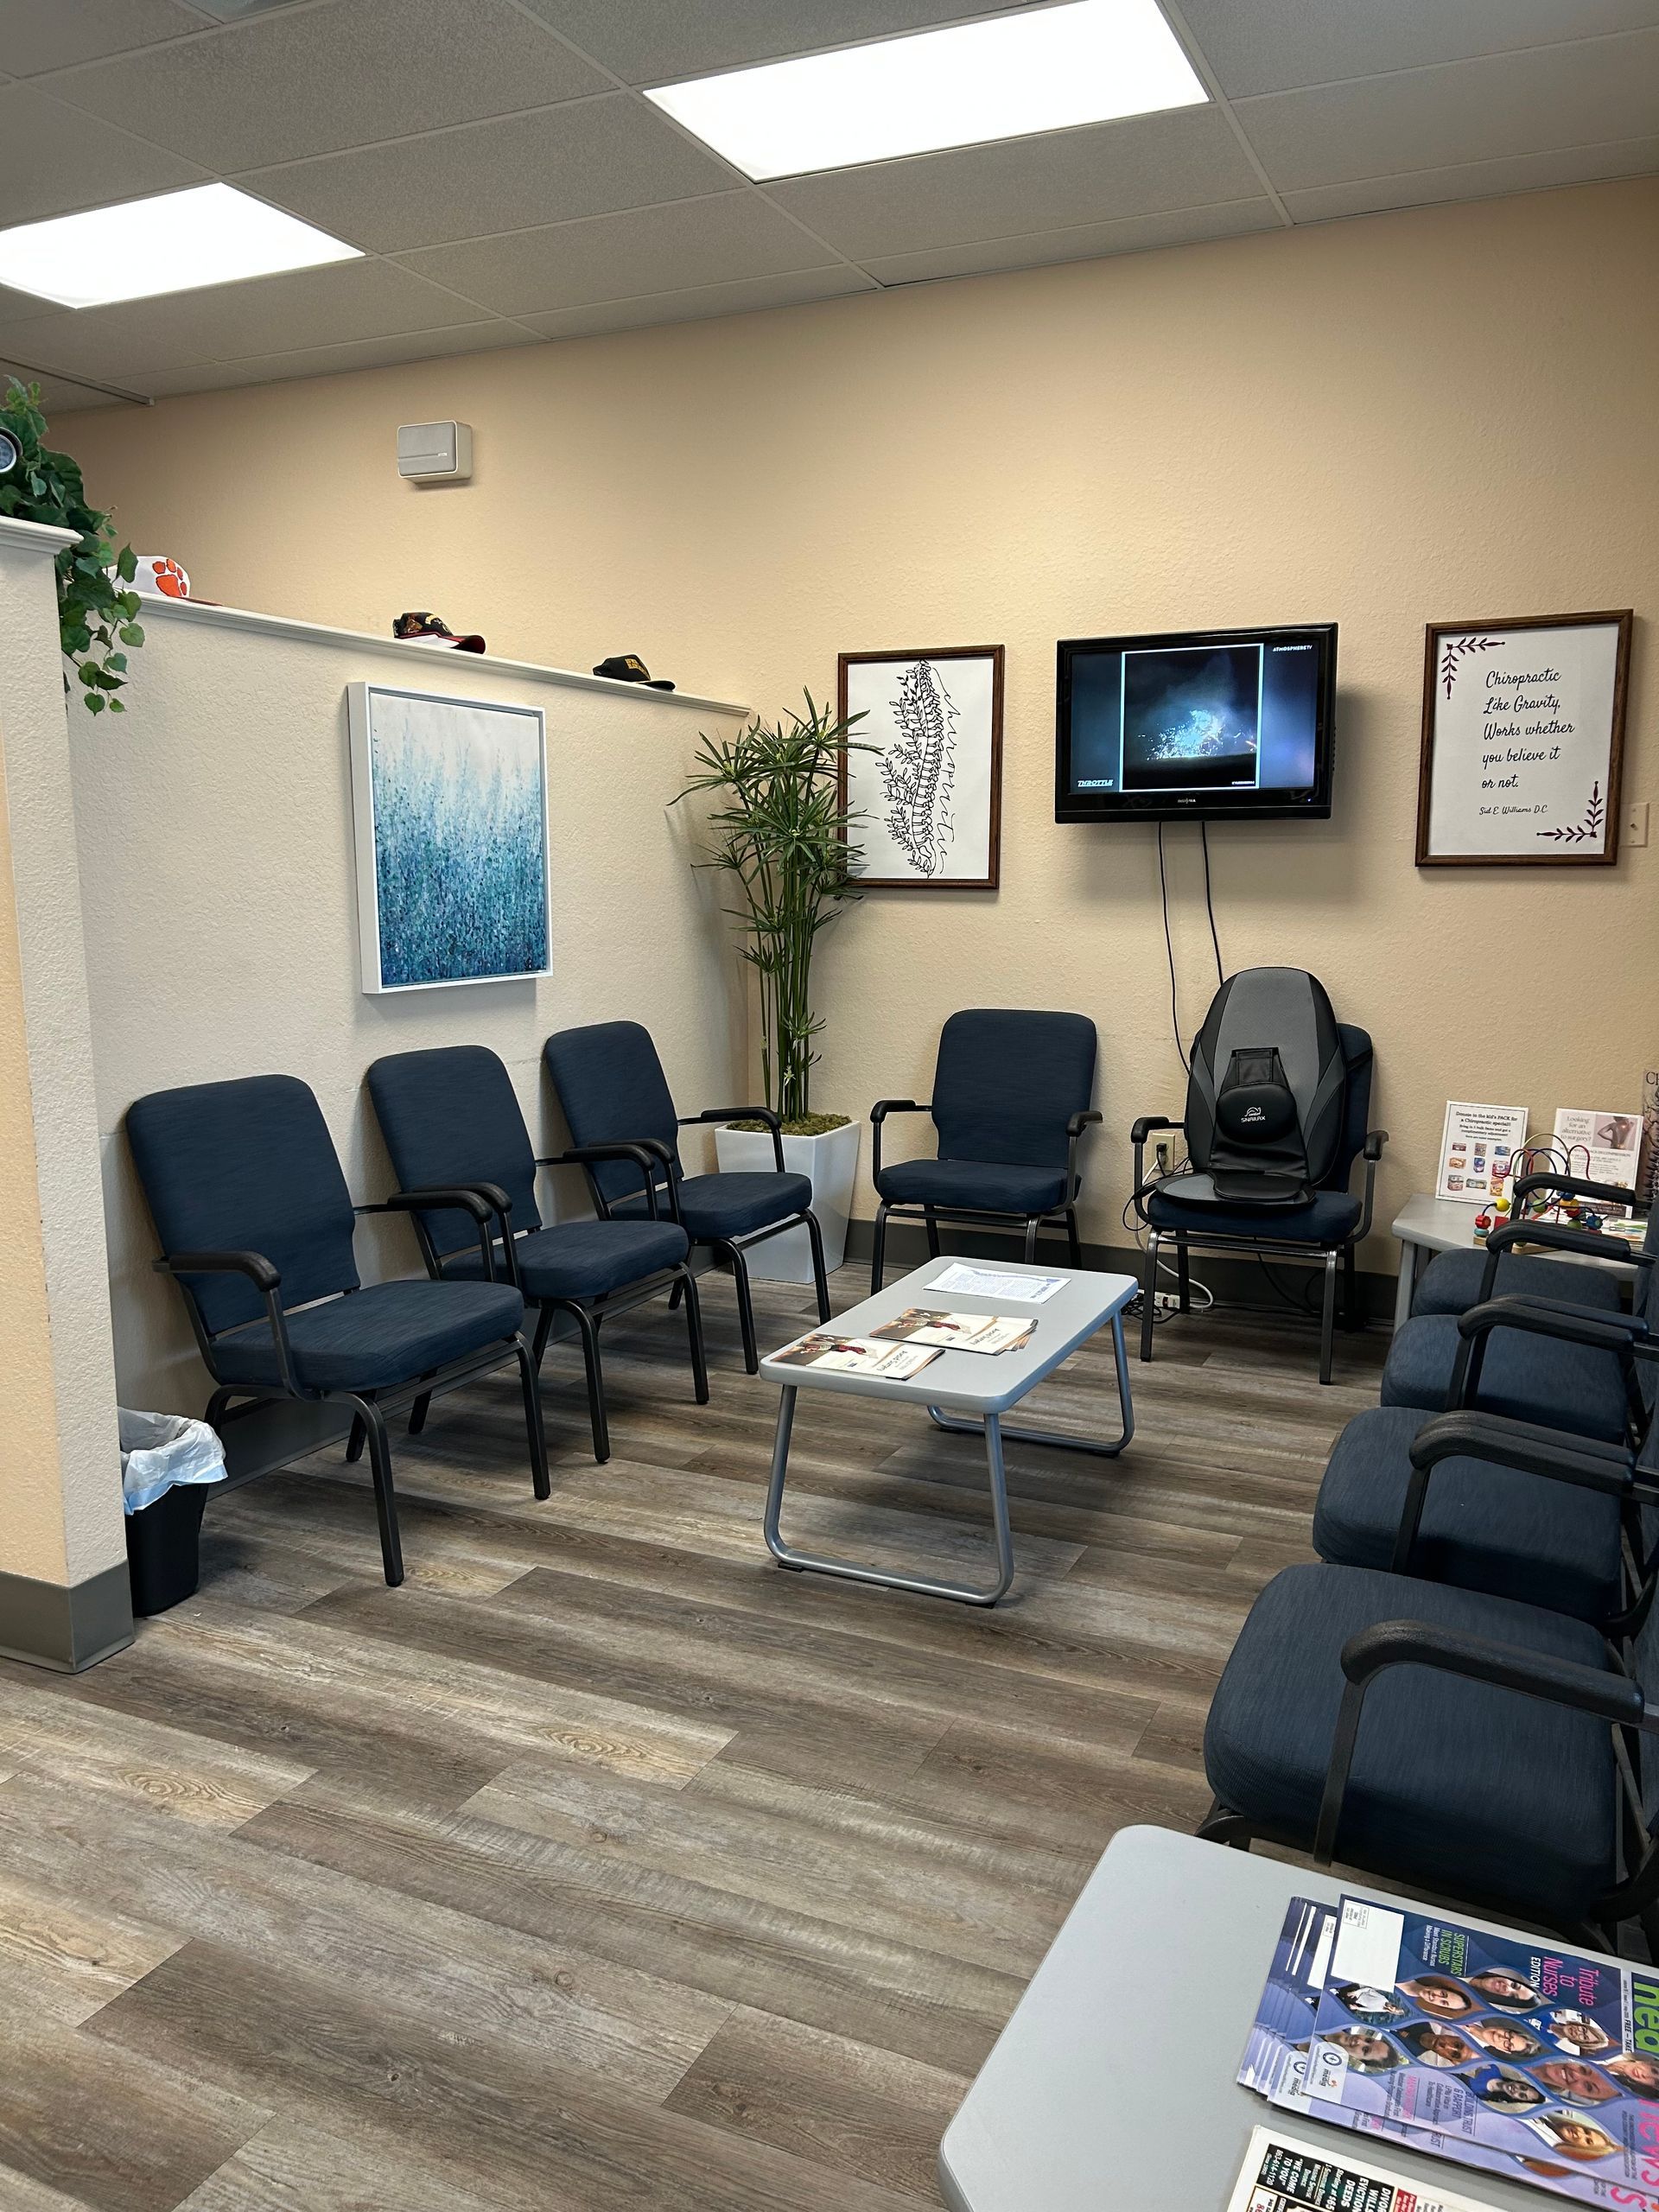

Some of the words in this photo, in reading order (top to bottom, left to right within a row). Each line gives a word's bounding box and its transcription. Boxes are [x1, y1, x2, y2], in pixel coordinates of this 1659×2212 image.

[1486, 668, 1561, 690] Chiropractic
[1483, 696, 1511, 714] Like
[1484, 722, 1521, 740] Works
[1525, 720, 1575, 735] whether
[1483, 753, 1503, 770] you
[1507, 747, 1546, 763] believe
[1550, 747, 1560, 760] it
[1481, 779, 1496, 788] or
[1479, 806, 1491, 815] Sid
[1502, 805, 1531, 815] Williams
[1441, 1929, 1452, 1938] IN
[1439, 1938, 1452, 1965] SCRUBS
[1451, 1933, 1465, 1976] SUPERSTARS
[1530, 1956, 1541, 1987] EDITION
[1542, 1956, 1563, 1997] Nurses
[1560, 1974, 1578, 1987] to
[1579, 1967, 1600, 2005] Tribute
[1462, 2116, 1473, 2134] TRUST
[1431, 2133, 1442, 2147] RUST
[1283, 2157, 1293, 2166] TO
[1287, 2171, 1300, 2194] COME
[1340, 2179, 1356, 2208] DEEDS
